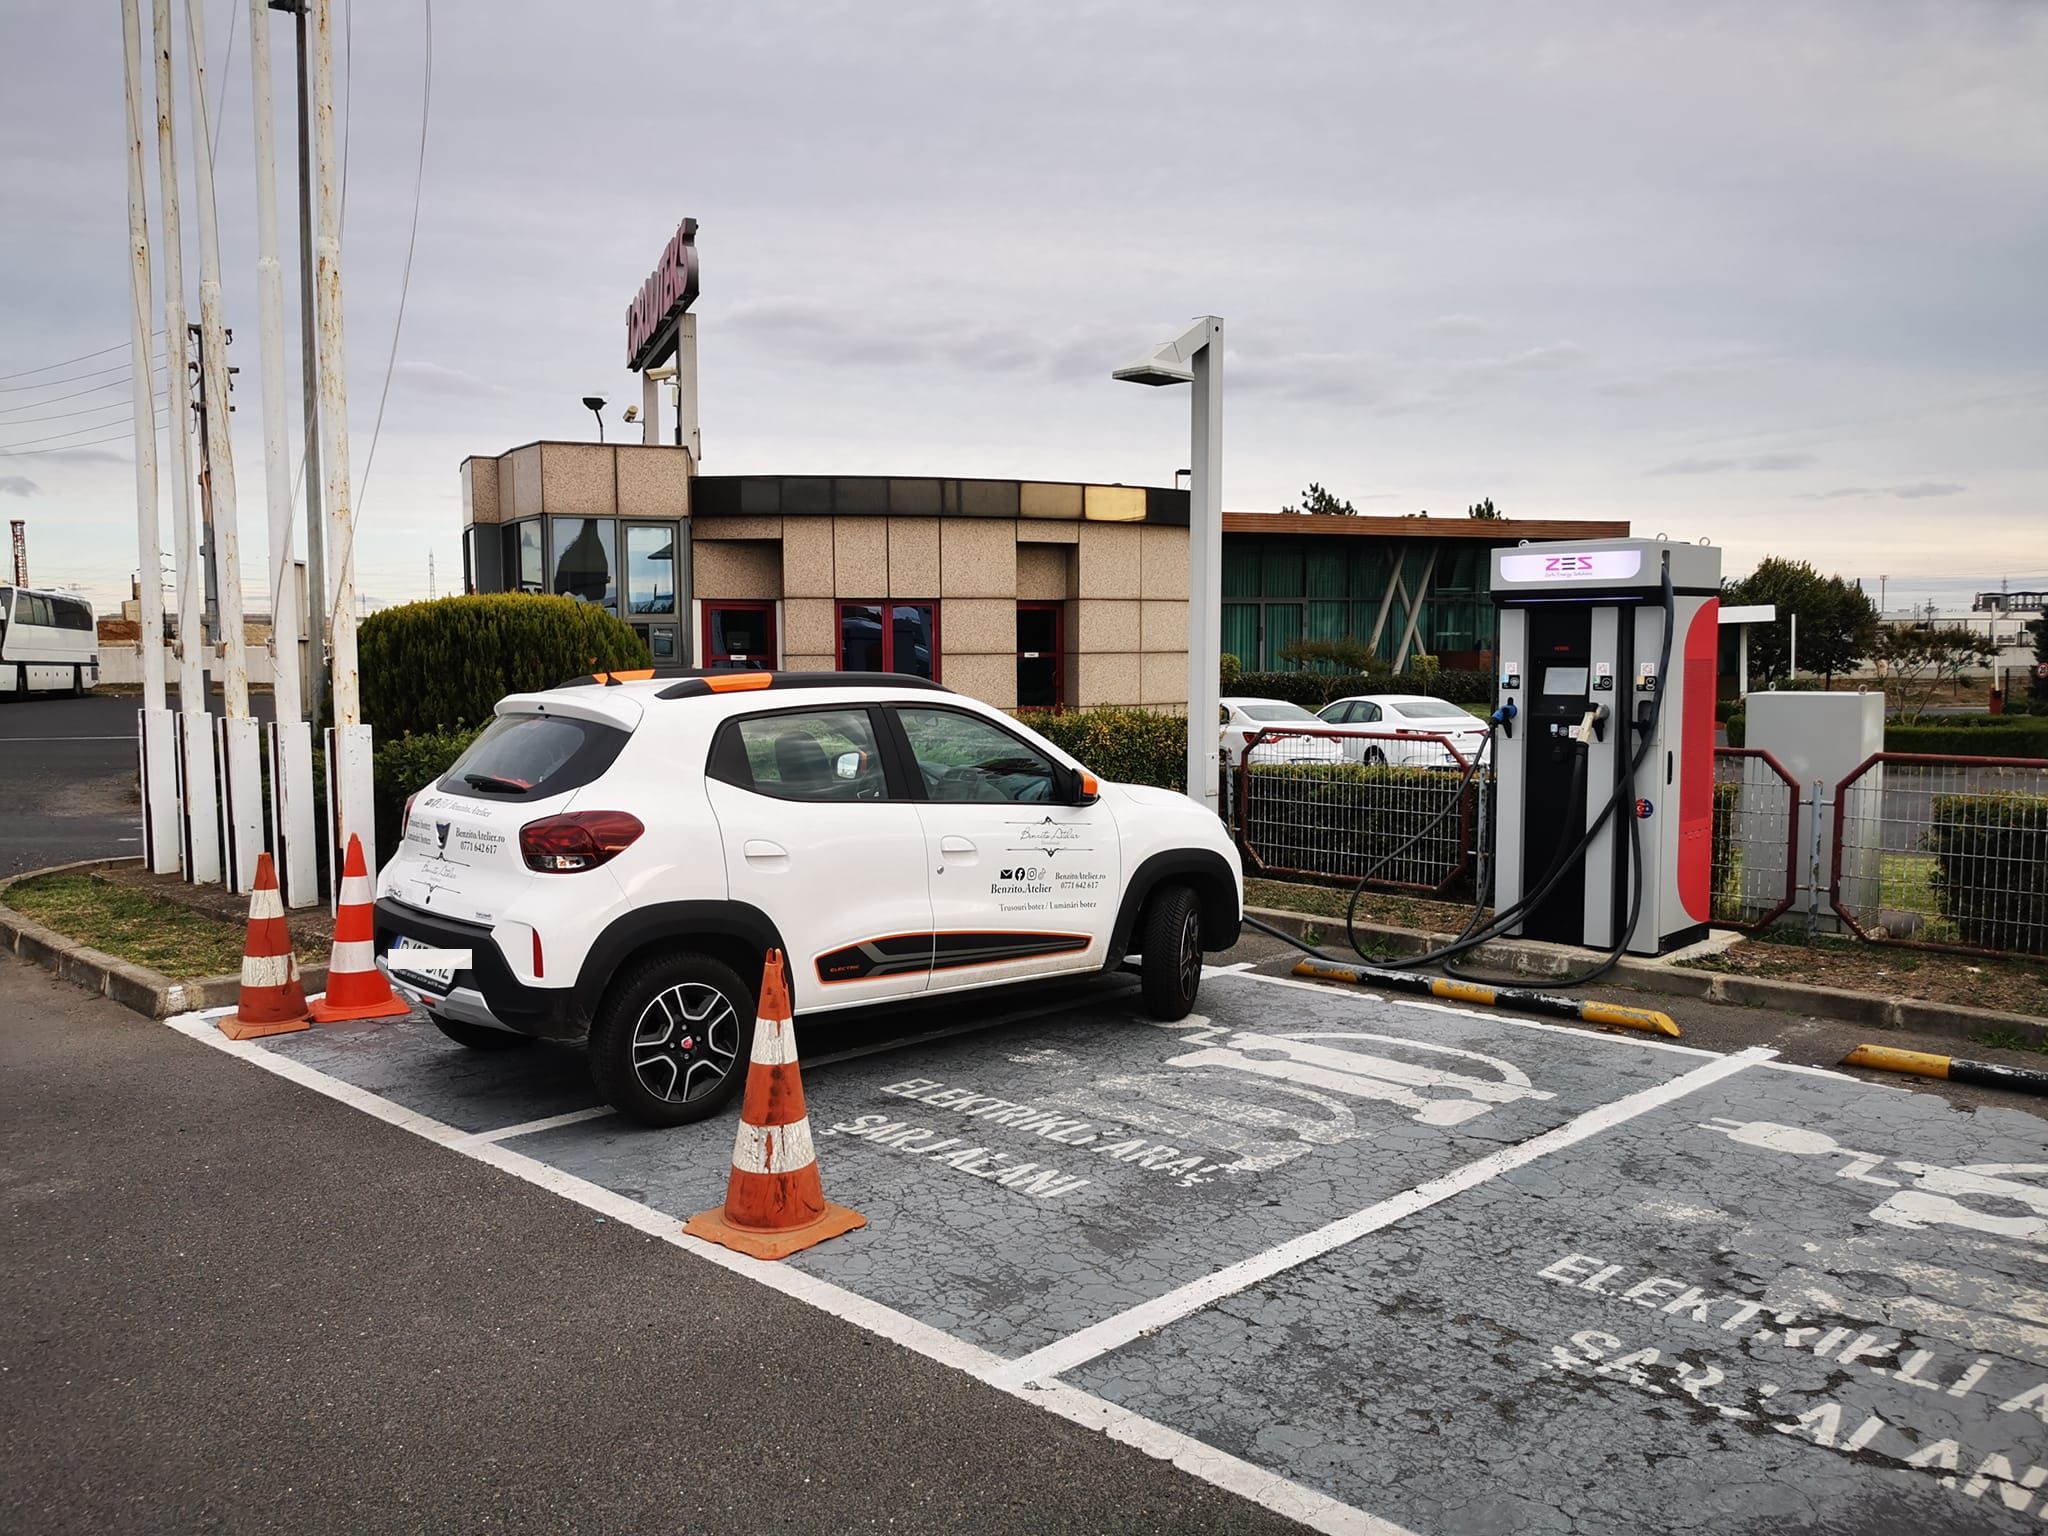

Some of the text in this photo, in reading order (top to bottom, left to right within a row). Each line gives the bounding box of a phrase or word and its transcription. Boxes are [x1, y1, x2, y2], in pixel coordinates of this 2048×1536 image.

[1545, 556, 1592, 571] ZES
[486, 844, 497, 854] 617
[991, 883, 1052, 894] Benzito.Atelier
